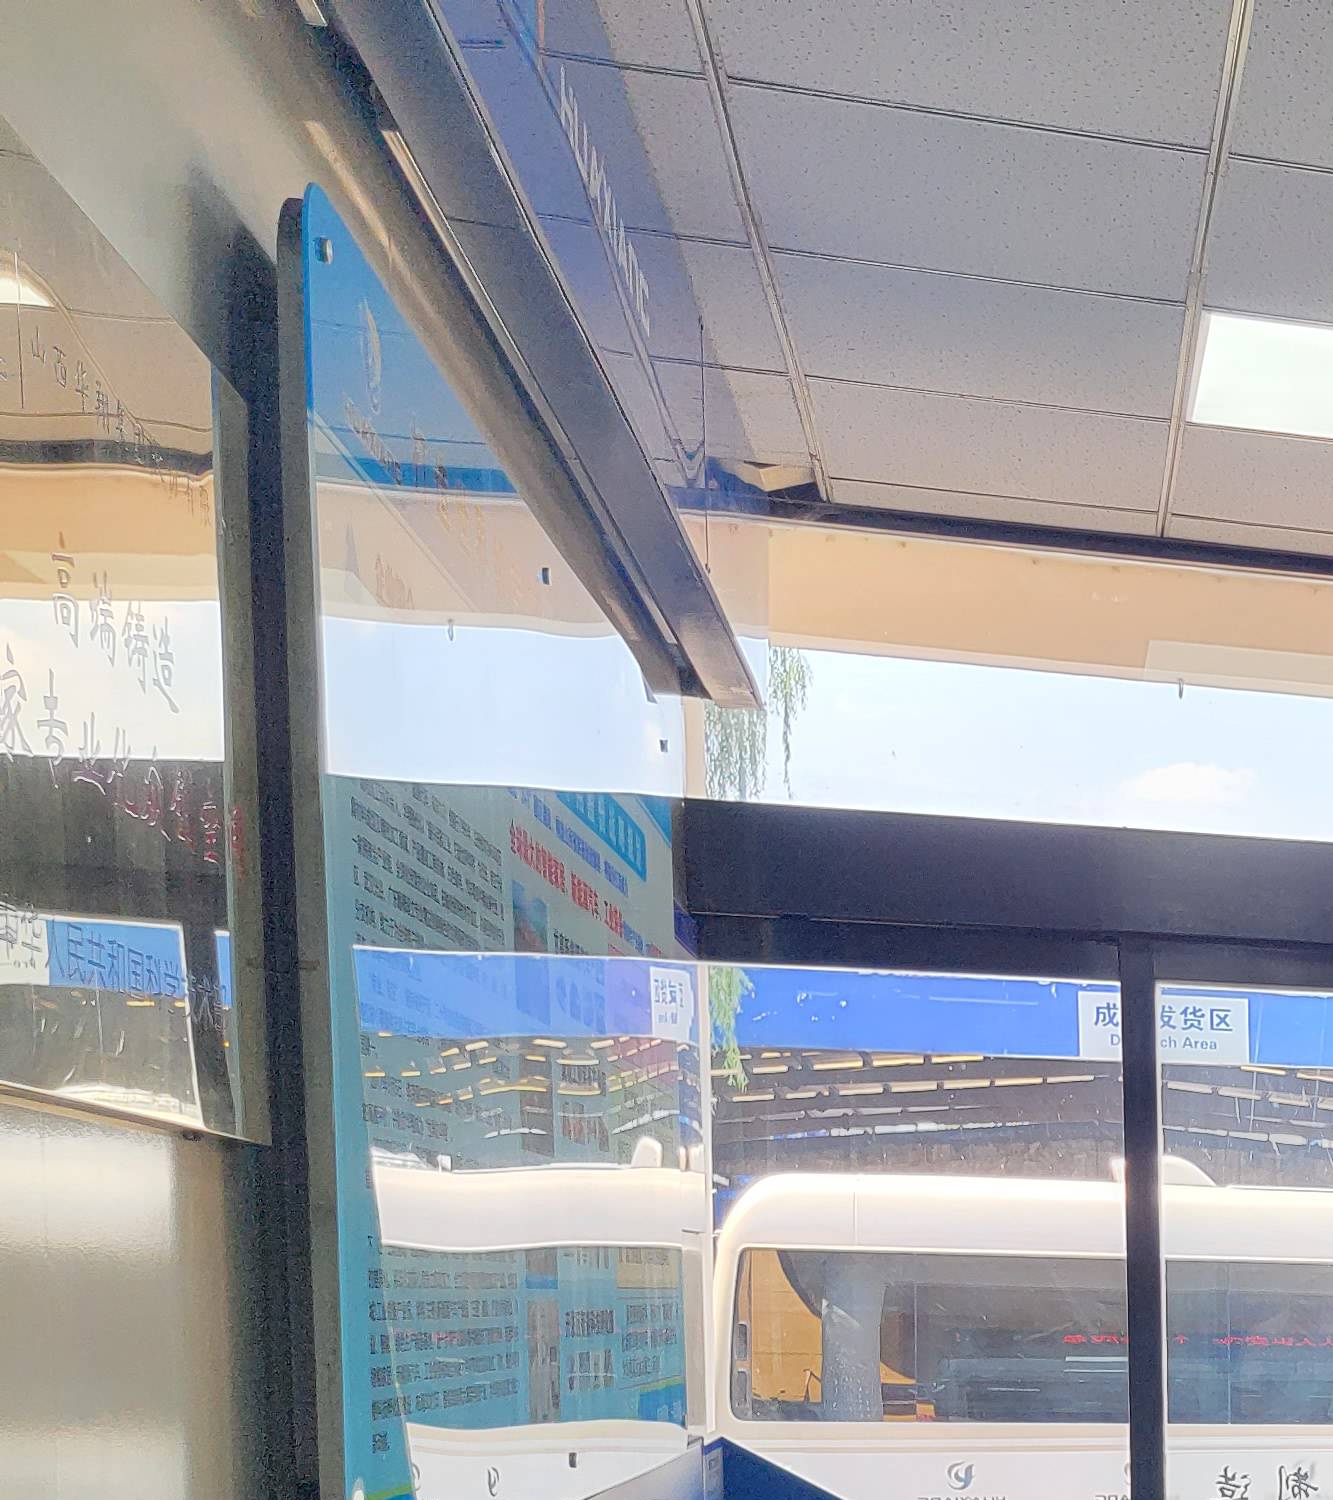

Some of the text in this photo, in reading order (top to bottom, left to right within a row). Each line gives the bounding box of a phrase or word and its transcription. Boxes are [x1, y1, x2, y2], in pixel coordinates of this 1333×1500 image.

[1093, 1002, 1233, 1032] 成发货区
[1182, 1036, 1218, 1050] Area
